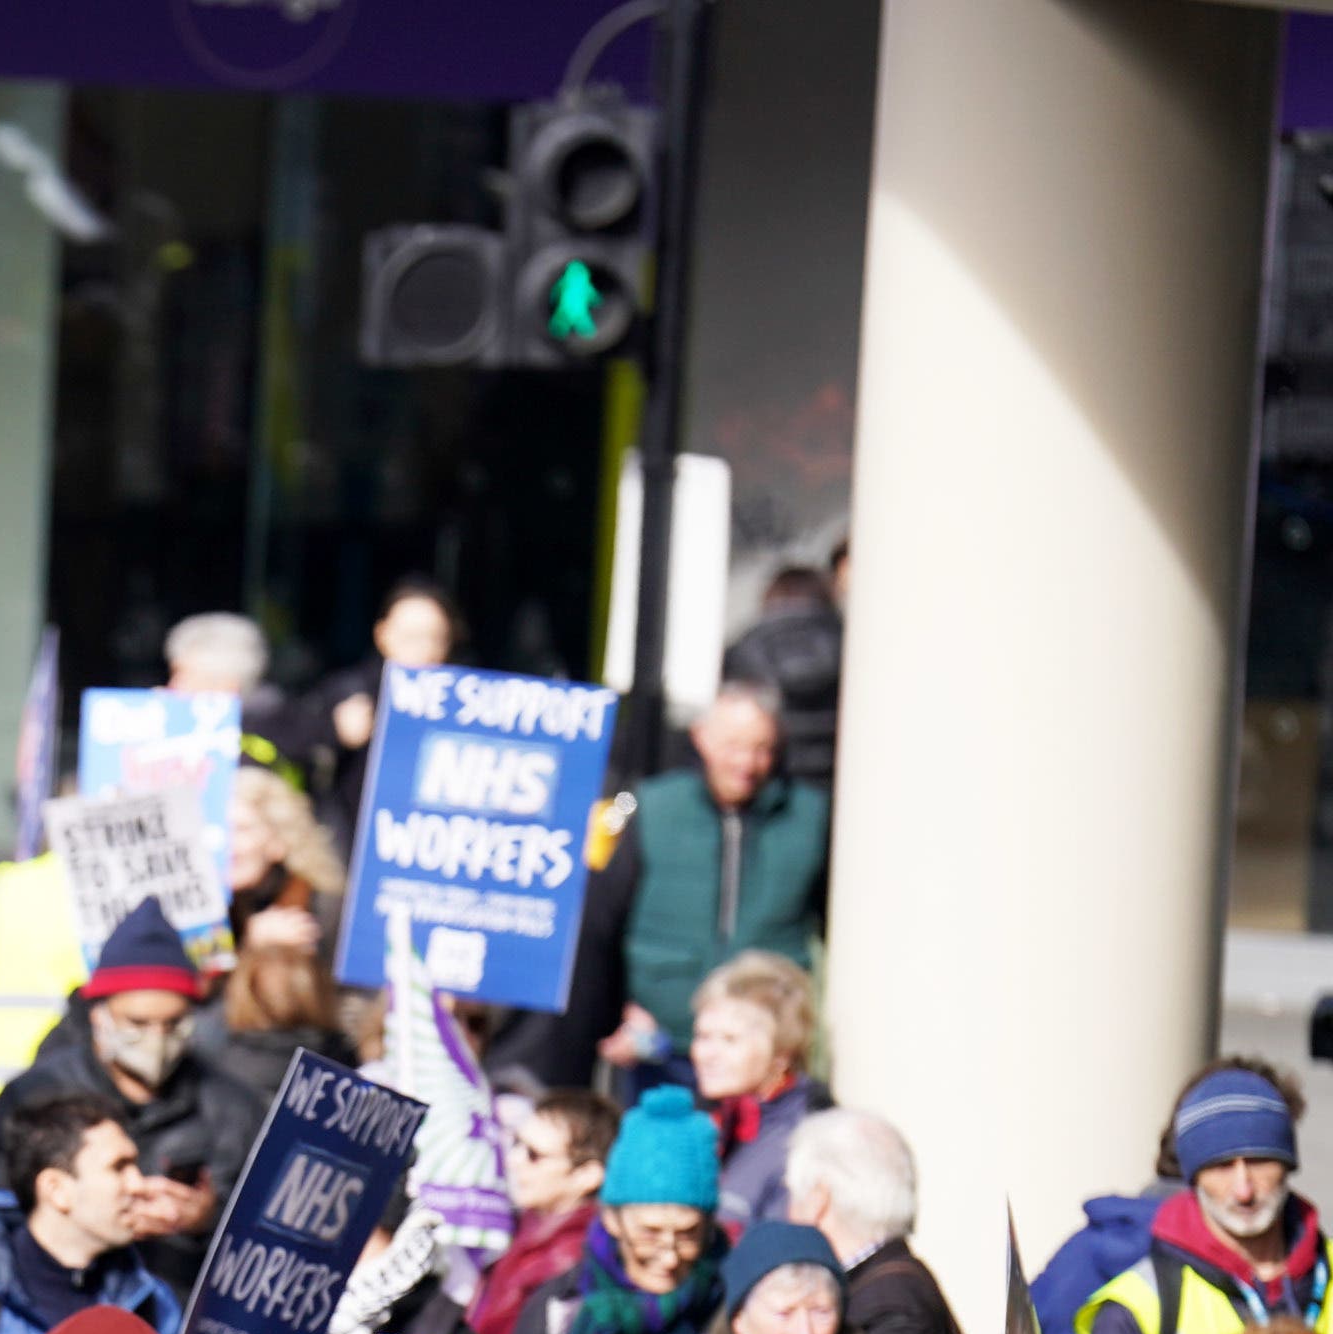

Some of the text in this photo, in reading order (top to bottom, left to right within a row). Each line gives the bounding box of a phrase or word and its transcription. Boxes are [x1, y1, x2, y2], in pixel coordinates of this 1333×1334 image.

[389, 668, 619, 741] WE SUPPORT
[419, 739, 557, 814] NHS
[375, 808, 573, 889] WORKERS
[287, 1063, 427, 1155] WE SUPPORT
[266, 1155, 364, 1242] NHS
[211, 1232, 341, 1333] WORKERS
